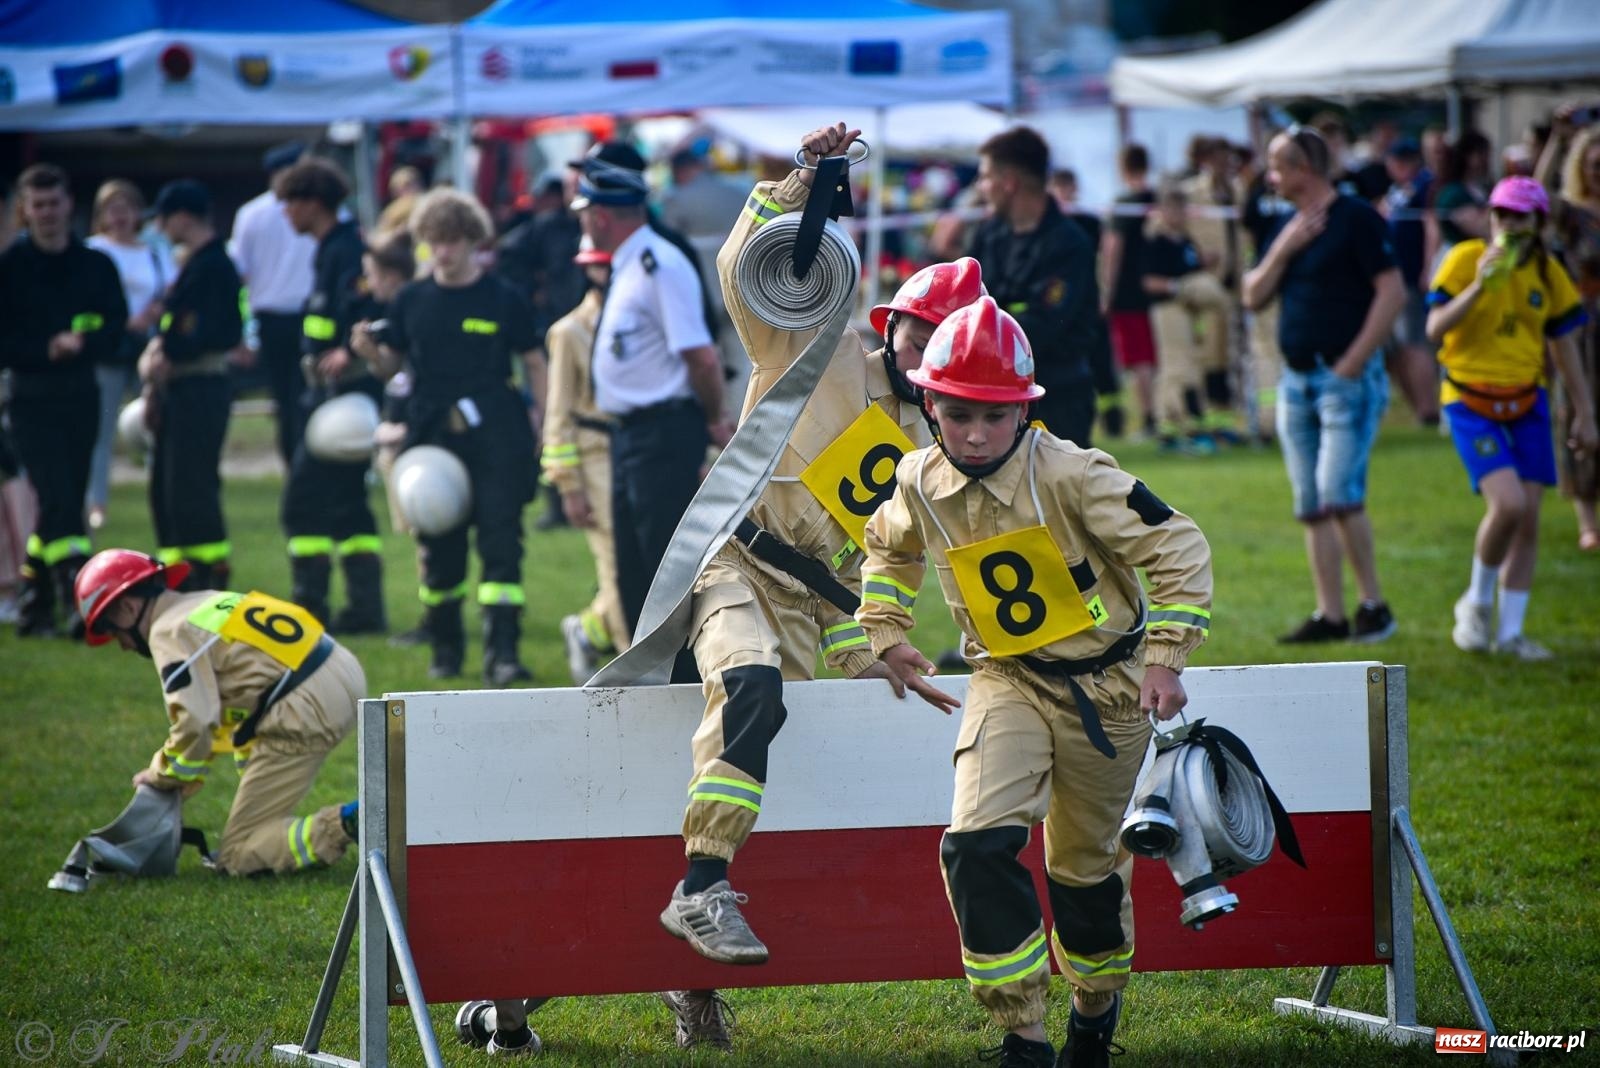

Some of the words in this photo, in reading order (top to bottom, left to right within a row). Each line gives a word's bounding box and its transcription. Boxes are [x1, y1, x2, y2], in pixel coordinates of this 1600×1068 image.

[838, 443, 904, 517] 9
[244, 606, 304, 644] 6
[980, 550, 1047, 636] 8
